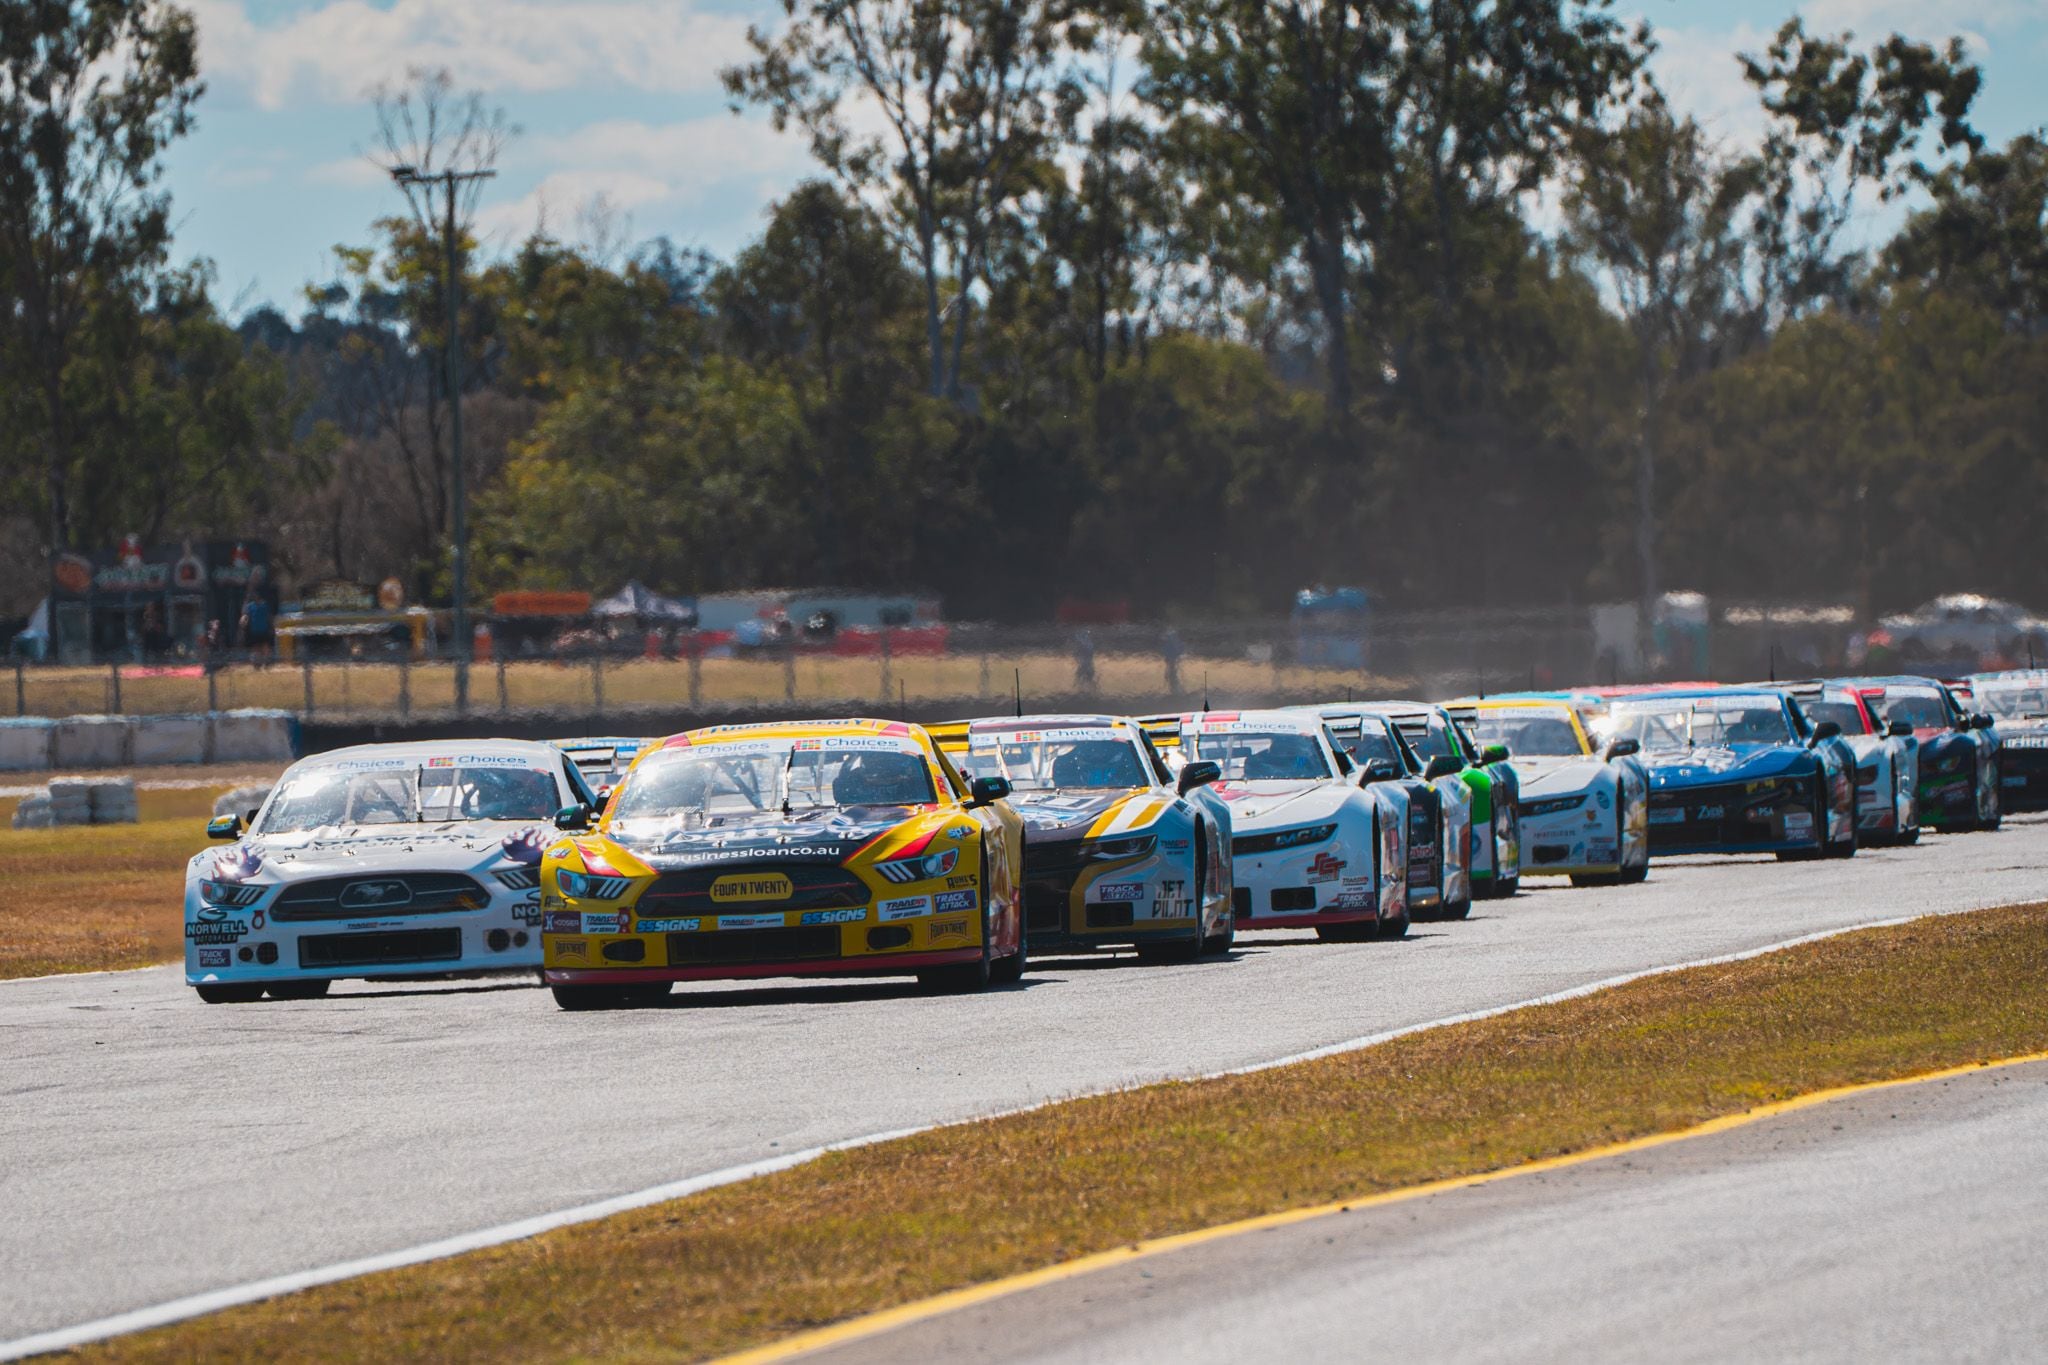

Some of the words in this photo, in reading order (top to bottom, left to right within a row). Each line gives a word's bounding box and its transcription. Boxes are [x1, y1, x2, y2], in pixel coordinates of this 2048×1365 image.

[1046, 729, 1116, 738] Choices
[697, 741, 770, 753] Choices
[825, 737, 898, 747] Choices
[337, 758, 405, 770] Choices
[458, 754, 527, 765] Choices
[667, 845, 840, 864] businessloanco.au
[713, 881, 747, 898] FOUR'N
[750, 879, 789, 895] TWENTY
[1101, 884, 1136, 893] TRACK
[1158, 880, 1185, 899] JET
[935, 892, 966, 903] TRACK
[939, 900, 970, 910] ATTACK
[1151, 899, 1194, 918] PILOT
[187, 921, 248, 936] NORWELL
[199, 949, 224, 958] TRACK
